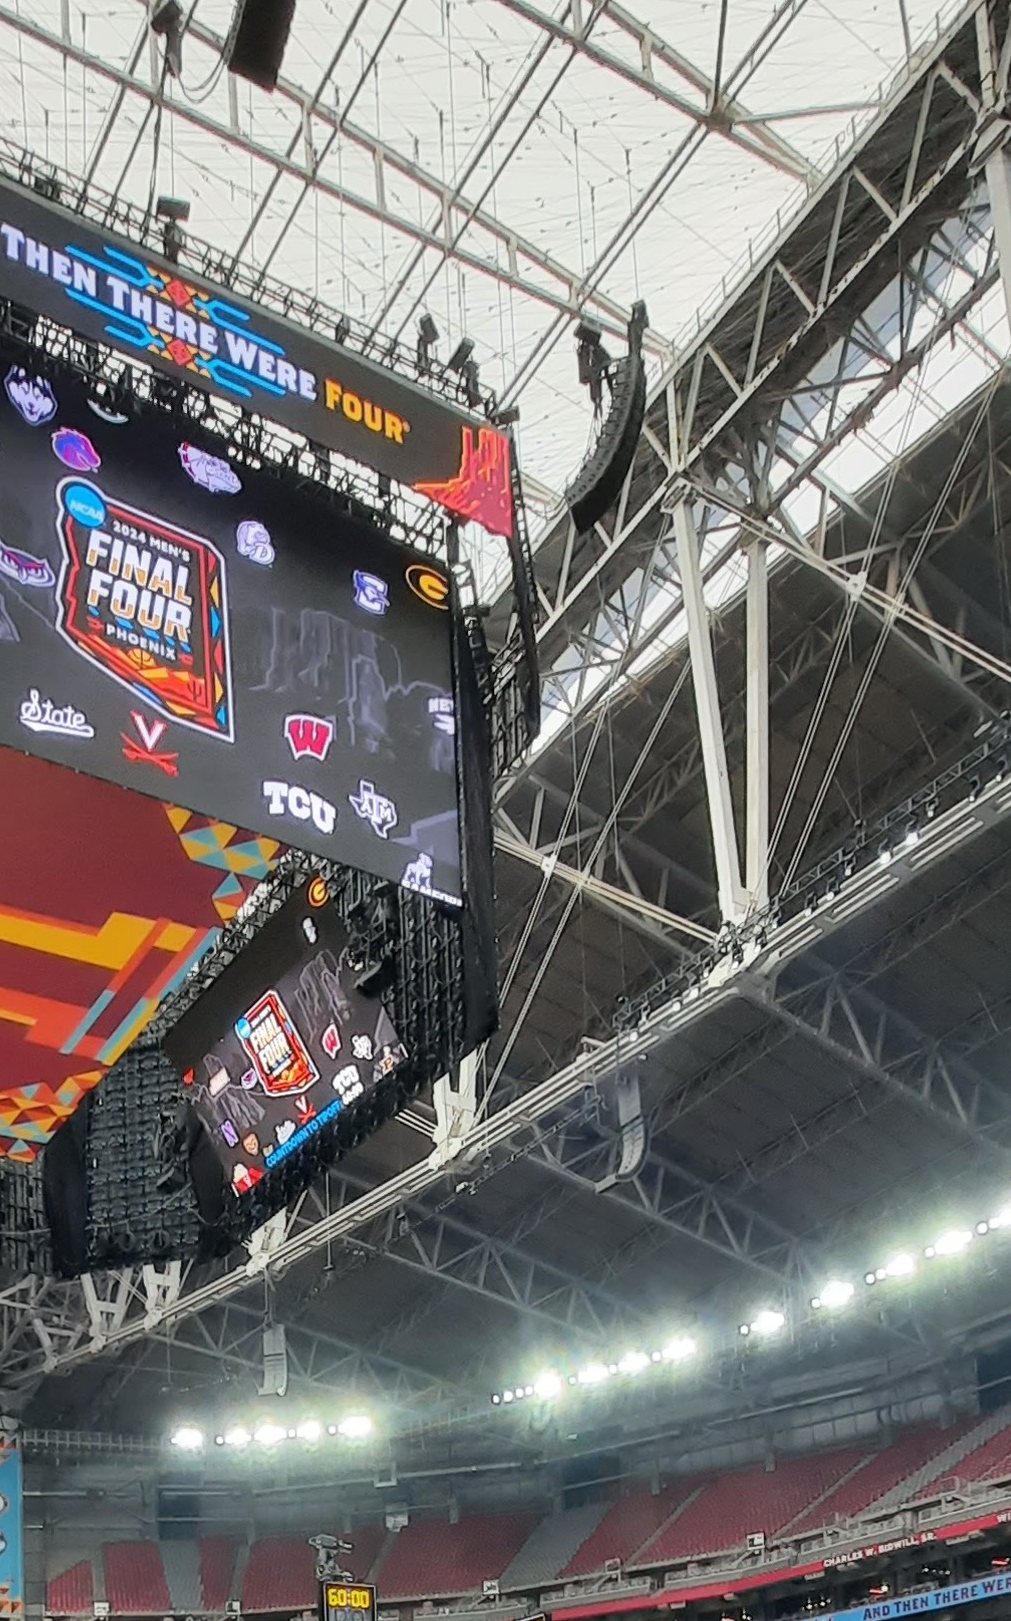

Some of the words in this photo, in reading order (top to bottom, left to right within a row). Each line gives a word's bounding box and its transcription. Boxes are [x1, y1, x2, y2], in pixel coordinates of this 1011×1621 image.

[0, 222, 97, 297] THEN
[107, 275, 218, 351] THERE
[225, 328, 318, 401] WERE
[324, 378, 405, 444] FOUR
[113, 520, 146, 541] 2024
[149, 536, 191, 562] MEN'S
[86, 529, 192, 604] FINAL
[87, 569, 193, 643] FOUR
[106, 624, 176, 661] PHOENIX
[20, 689, 94, 738] State
[288, 720, 332, 758] W
[263, 781, 336, 834] TCU
[249, 1013, 282, 1054] FINAL
[258, 1032, 291, 1074] FOUR
[823, 1551, 863, 1568] CHARLES
[328, 1588, 369, 1608] 60:00
[863, 1605, 890, 1621] AND
[894, 1596, 930, 1613] THEN
[934, 1585, 978, 1605] THERE
